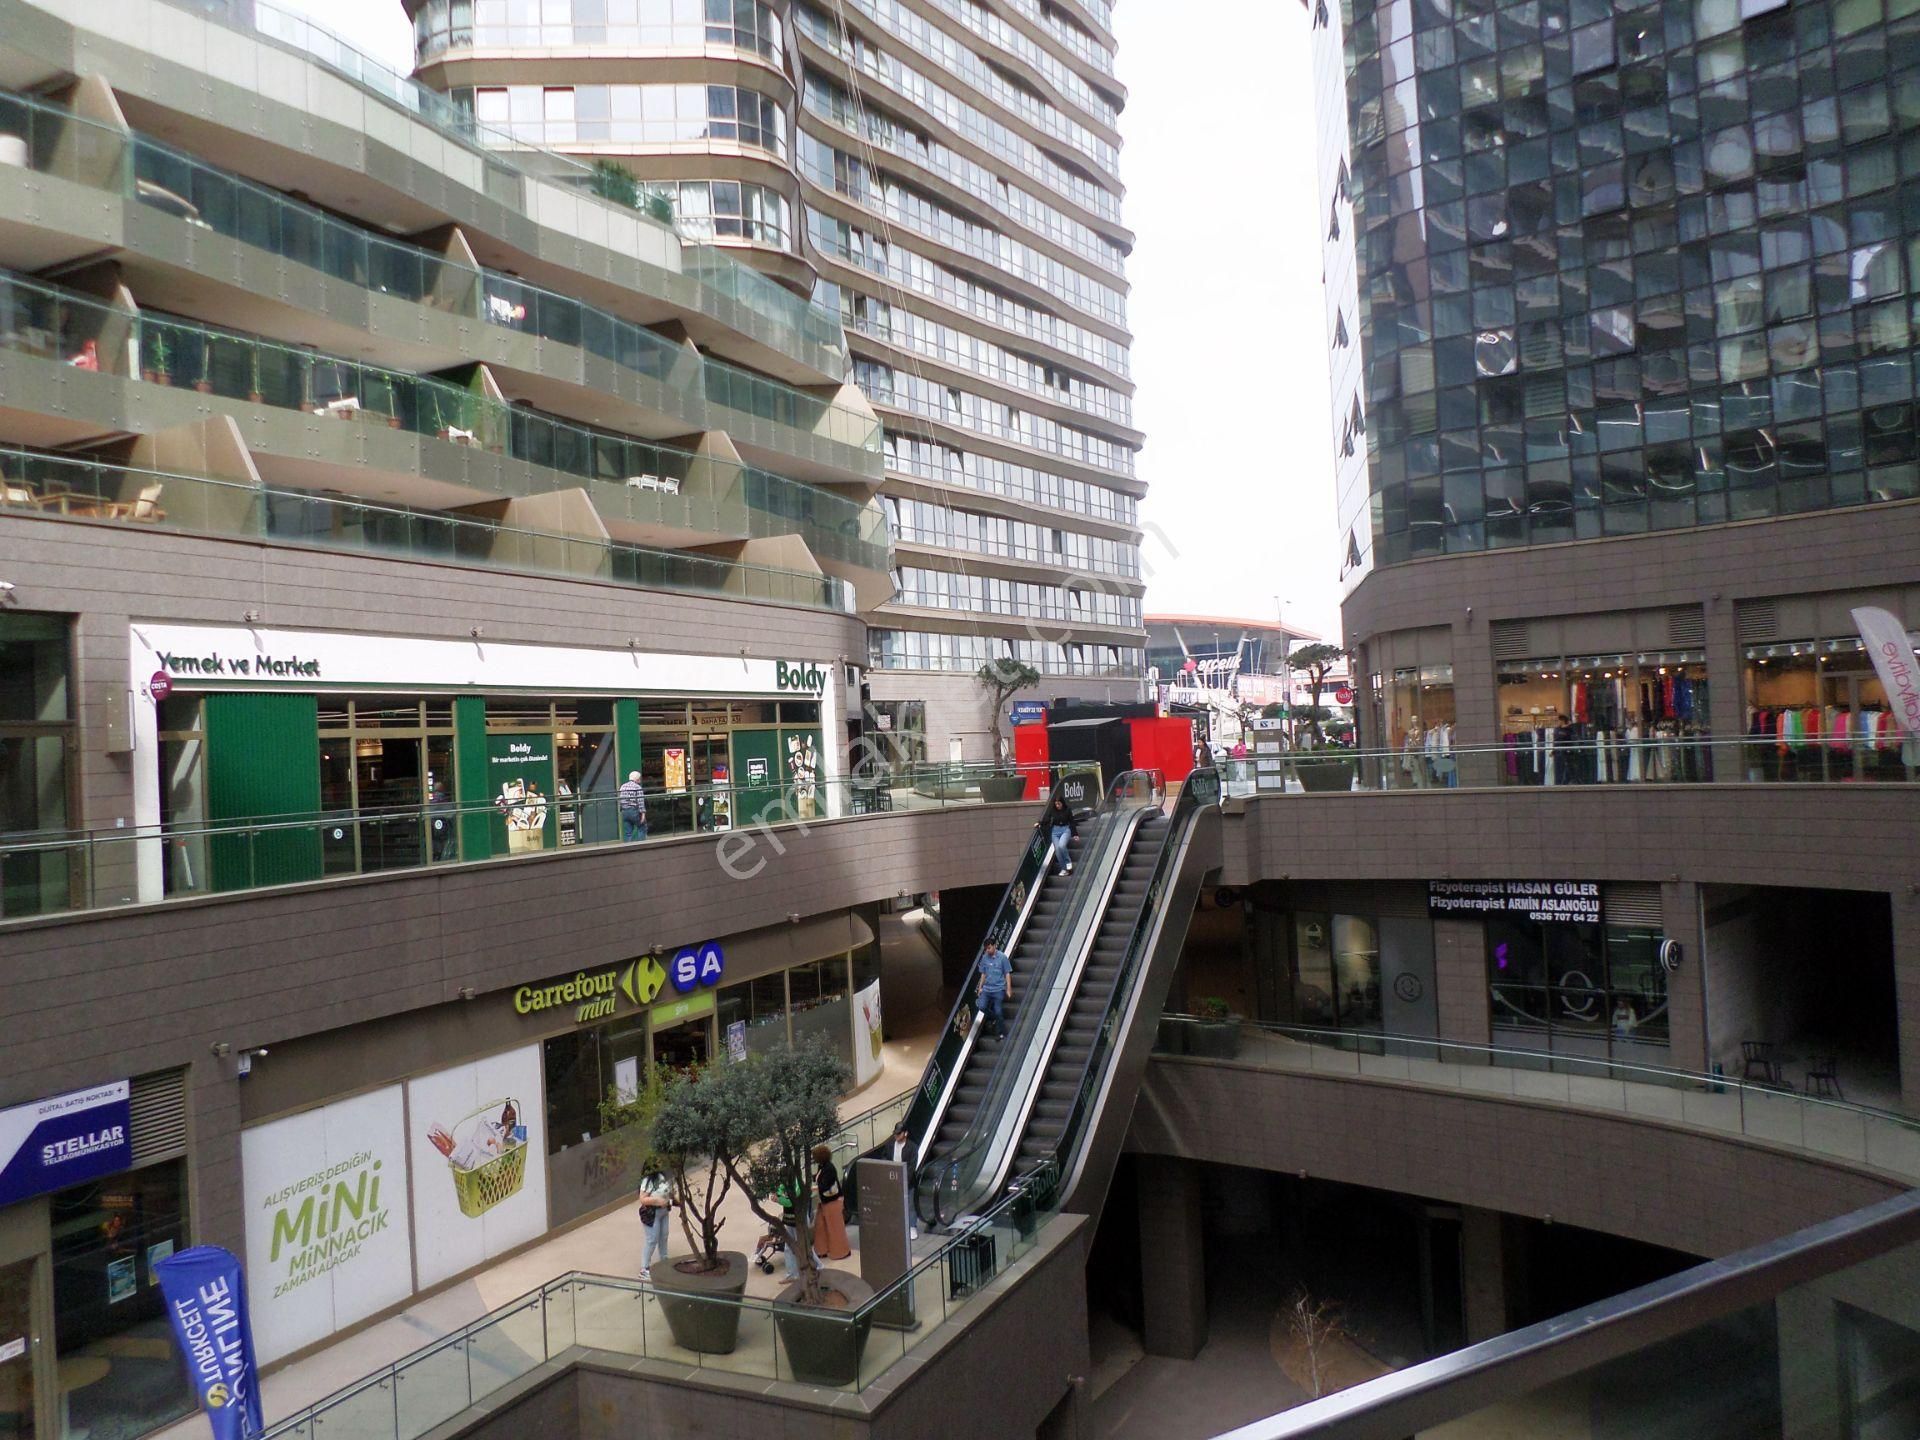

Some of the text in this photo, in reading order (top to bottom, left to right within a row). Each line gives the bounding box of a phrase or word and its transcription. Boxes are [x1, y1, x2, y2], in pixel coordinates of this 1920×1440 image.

[156, 651, 321, 677] Yemek ve Market
[776, 660, 826, 696] Boldy
[151, 681, 167, 690] COSTA
[510, 743, 531, 754] Boldy
[1064, 781, 1084, 801] Boldy
[1429, 880, 1599, 896] Fizyoterapist HASAN GÜLER
[1430, 896, 1505, 911] Fizyoterapist
[1541, 897, 1599, 912] ASLANOĞLU
[1529, 912, 1599, 922] 0536 707 64 22
[677, 950, 722, 983] SA
[515, 971, 617, 1014] Carrefour
[577, 993, 616, 1023] mini
[43, 1125, 124, 1159] STELLAR
[325, 1150, 373, 1181] DEDİĞİN
[273, 1244, 362, 1299] ZAMAN ALACAK
